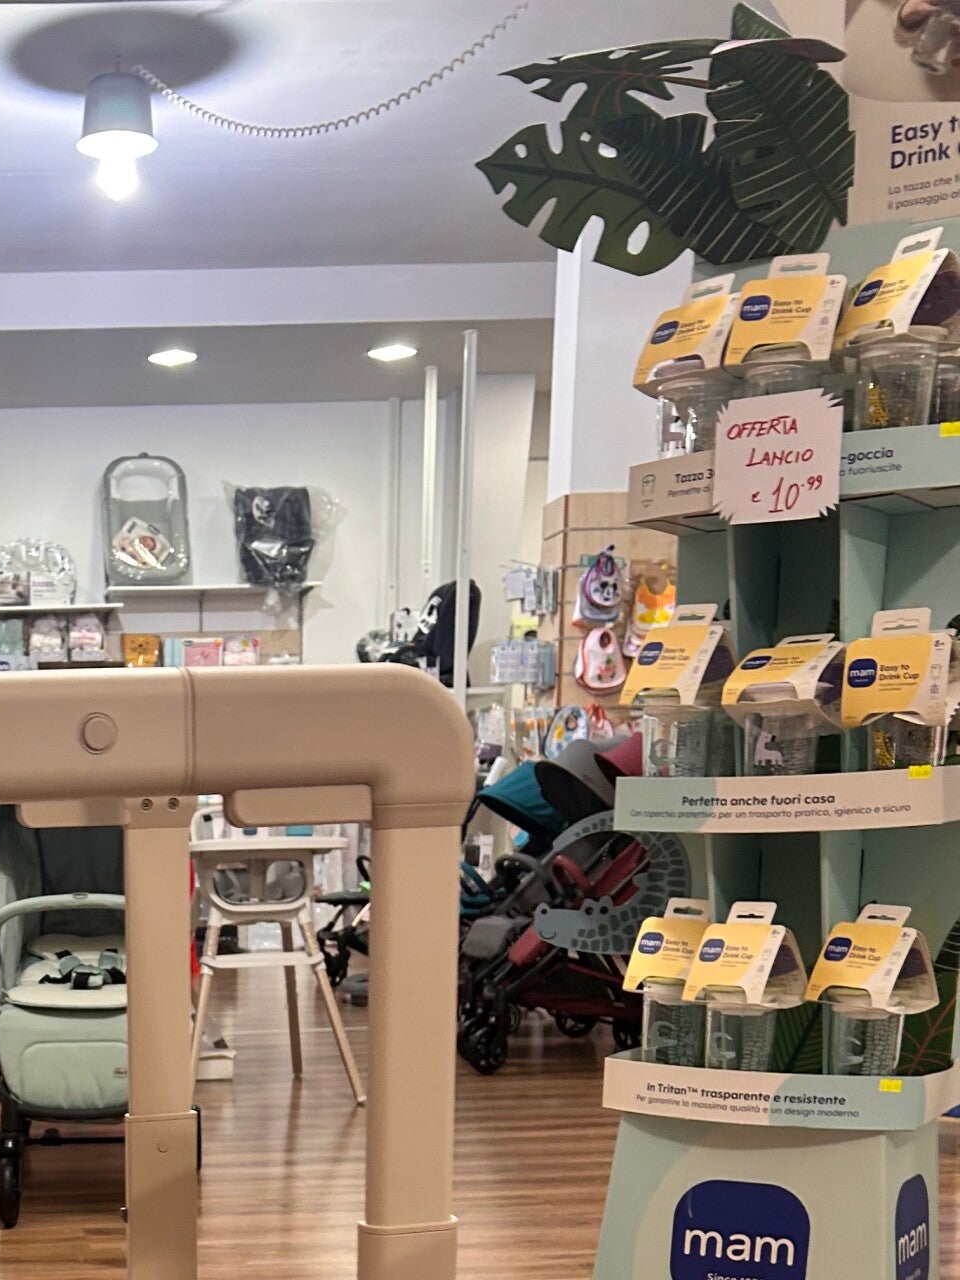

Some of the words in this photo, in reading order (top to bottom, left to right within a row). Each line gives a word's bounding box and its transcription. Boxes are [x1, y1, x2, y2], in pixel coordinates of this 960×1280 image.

[891, 121, 943, 144] Easy
[949, 115, 960, 133] t
[890, 142, 951, 169] Drink
[743, 303, 769, 312] mam
[726, 415, 799, 440] OFFERTA
[745, 447, 814, 467] LANCIO
[675, 472, 704, 483] Tazza
[849, 668, 875, 677] mam
[681, 795, 728, 806] Perfetta
[730, 795, 768, 806] anche
[770, 794, 801, 806] fuori
[804, 794, 835, 804] casa
[718, 811, 732, 820] per
[748, 808, 792, 820] trasporto
[833, 806, 872, 818] igienico
[882, 804, 911, 813] sicuro
[702, 946, 723, 954] mam
[827, 944, 848, 953] mam
[646, 1082, 655, 1092] In
[701, 1088, 770, 1102] trasparente
[773, 1094, 781, 1102] e
[784, 1094, 847, 1106] resistente
[635, 1094, 646, 1102] Per
[648, 1097, 681, 1106] garantire
[682, 1099, 690, 1107] la
[691, 1101, 728, 1111] massima
[784, 1107, 815, 1118] design
[817, 1108, 859, 1118] moderno
[683, 1228, 795, 1267] mam
[897, 1221, 928, 1266] mam
